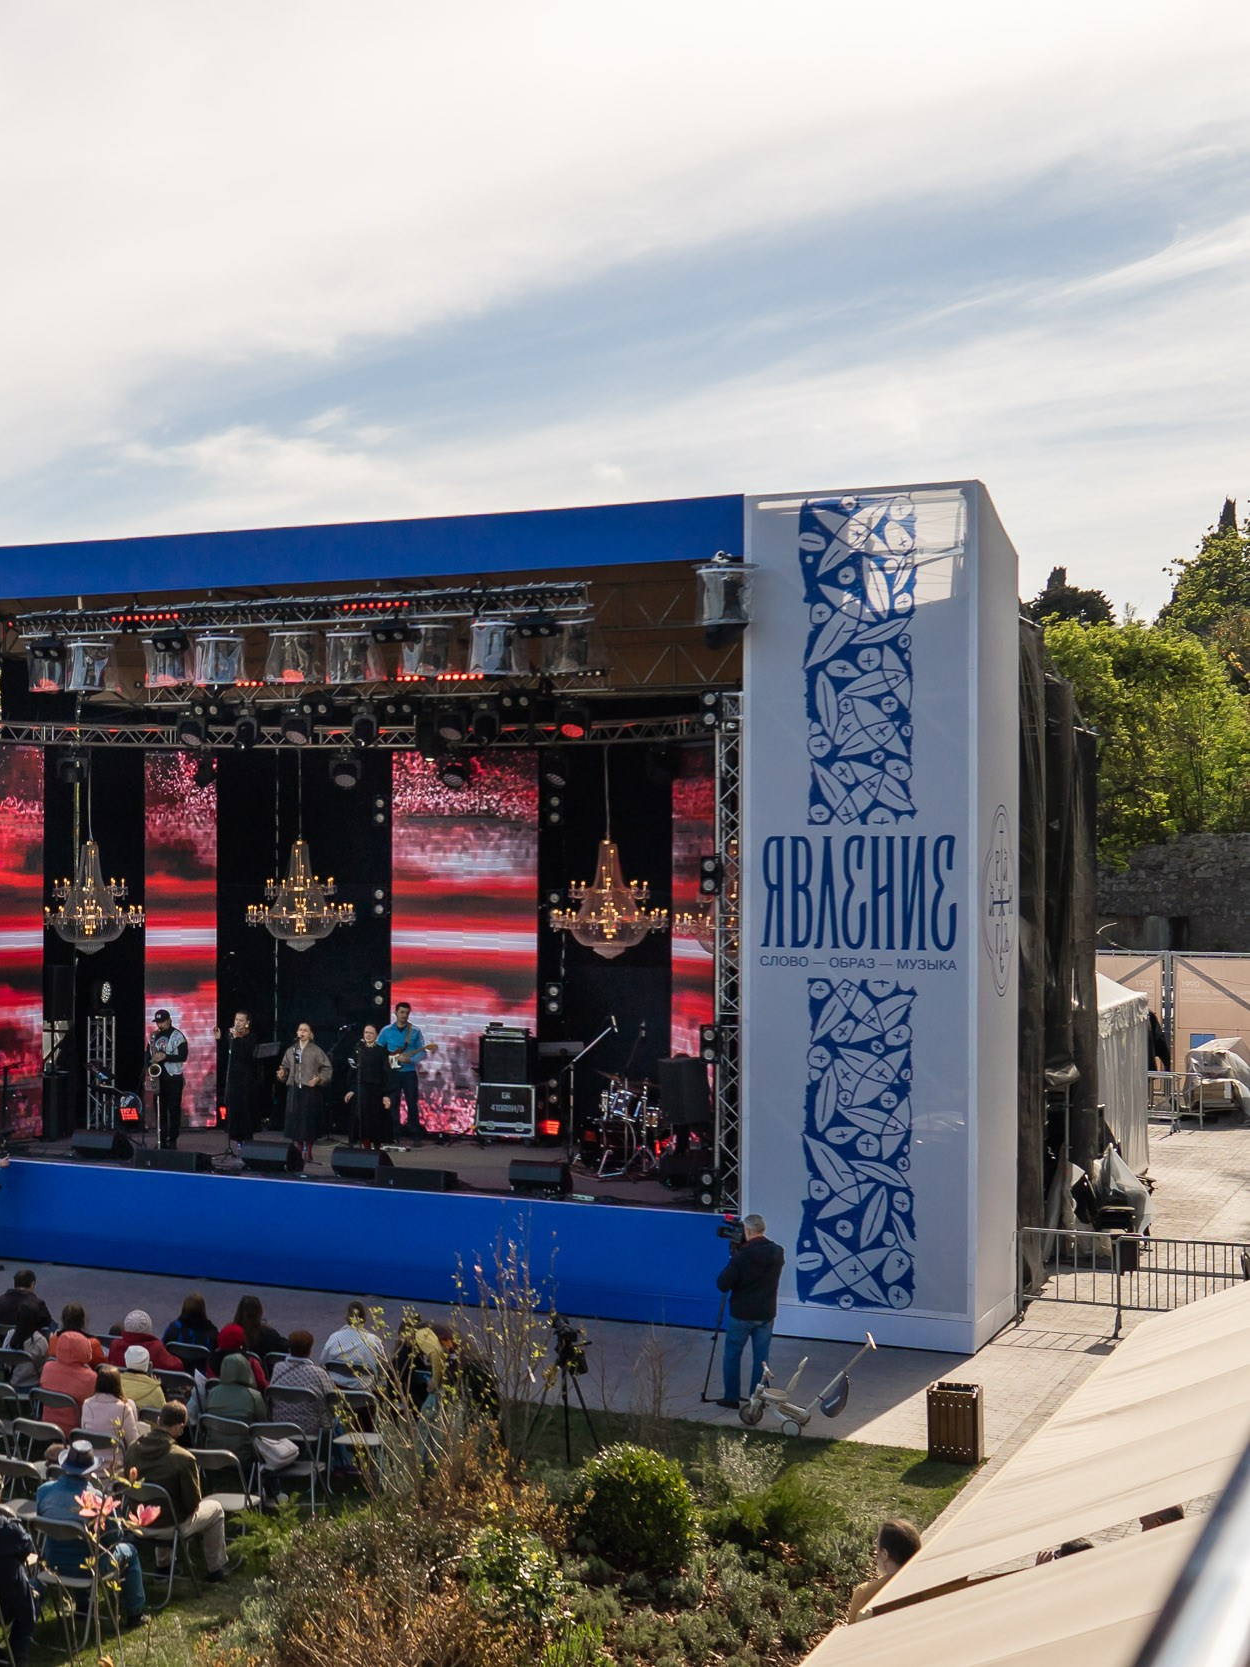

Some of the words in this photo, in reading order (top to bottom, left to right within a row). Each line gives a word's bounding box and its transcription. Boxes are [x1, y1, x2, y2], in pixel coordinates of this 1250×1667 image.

[760, 834, 958, 952] ЯВЛЕНИЕ
[759, 955, 809, 968] СЛОВО
[829, 957, 876, 969] ОБРАЗ
[896, 958, 958, 971] МУЗЫКА
